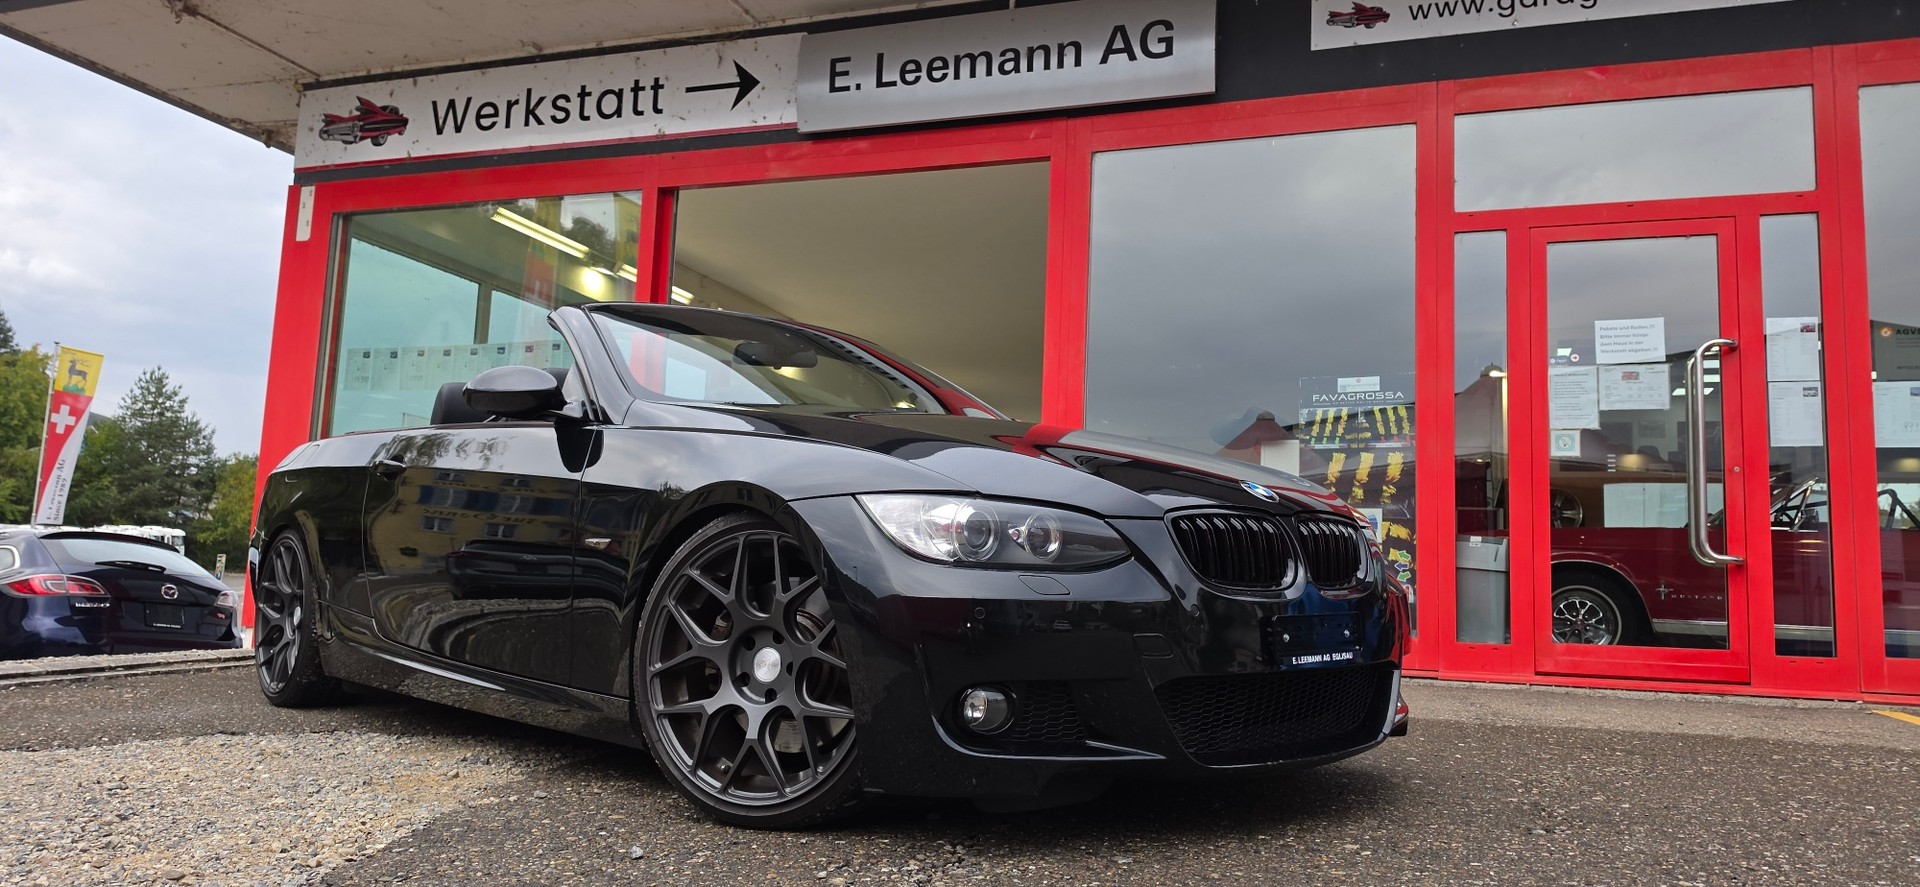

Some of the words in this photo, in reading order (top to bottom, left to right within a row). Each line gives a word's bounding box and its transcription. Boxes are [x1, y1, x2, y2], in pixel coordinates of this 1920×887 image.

[828, 57, 862, 94] E.
[875, 39, 1083, 89] Leemann
[1099, 18, 1175, 65] AG
[431, 77, 665, 136] Werkstatt
[1312, 391, 1404, 402] FAVAGROSSA
[1297, 654, 1322, 664] LEEMANN
[1323, 653, 1331, 661] AG
[1332, 651, 1353, 661] EGLISAU
